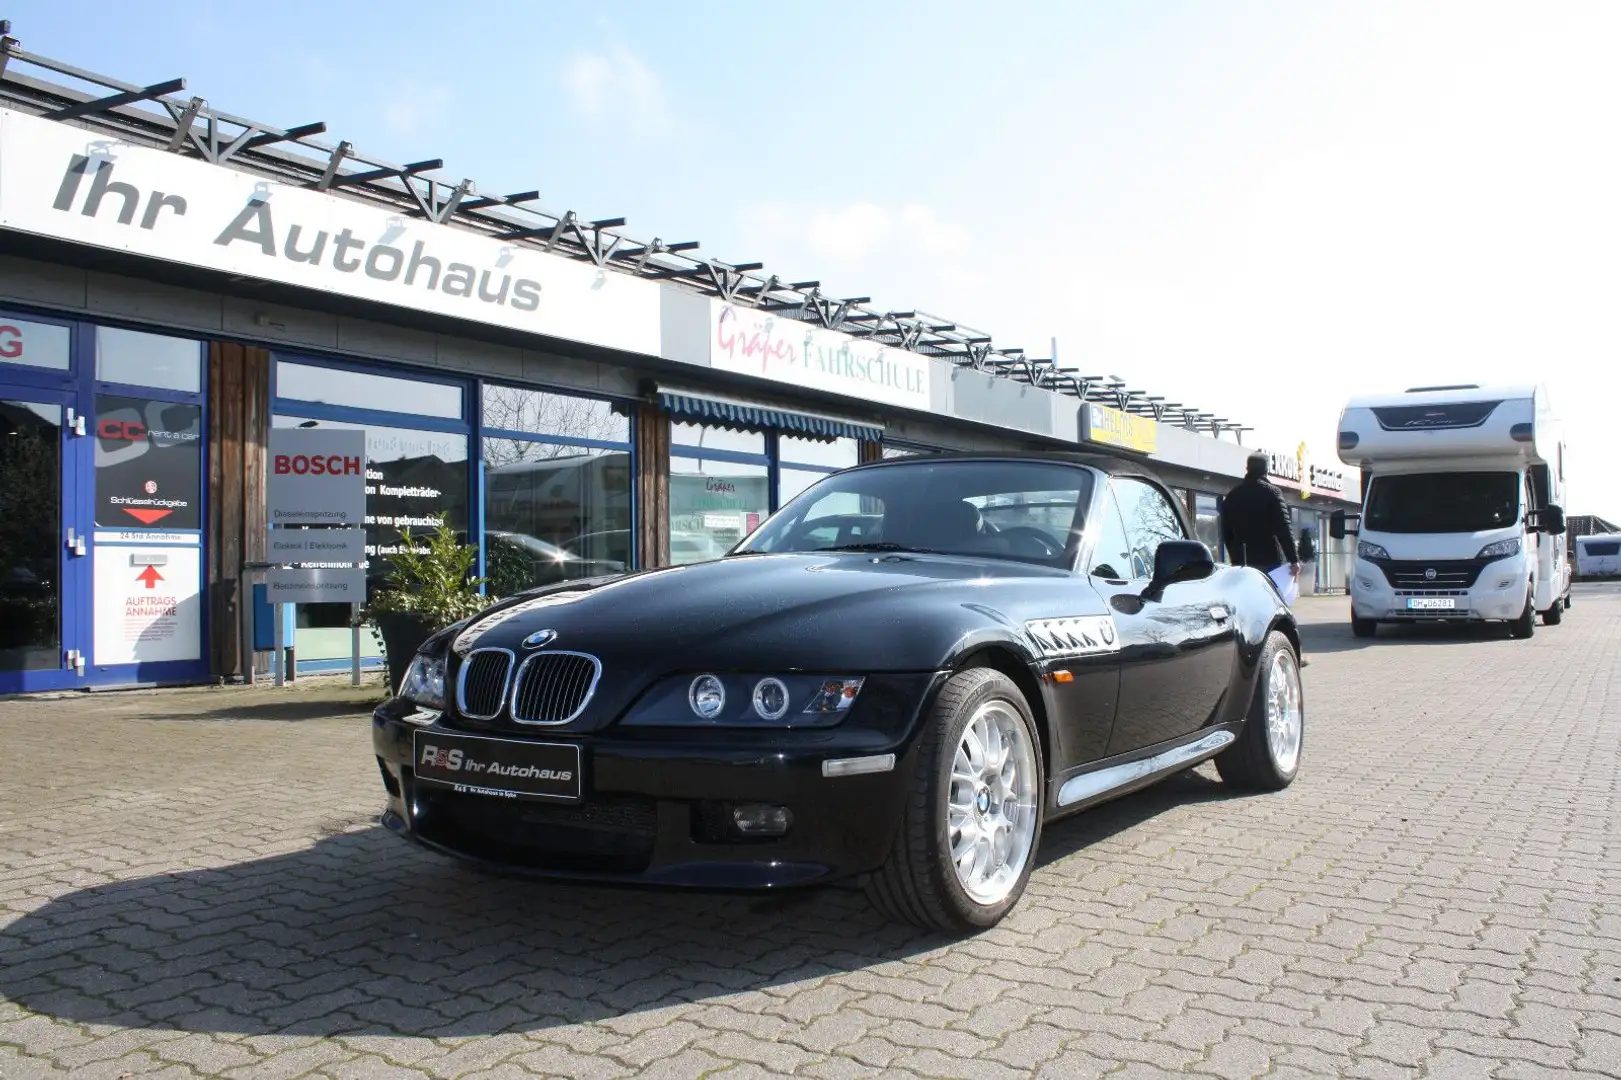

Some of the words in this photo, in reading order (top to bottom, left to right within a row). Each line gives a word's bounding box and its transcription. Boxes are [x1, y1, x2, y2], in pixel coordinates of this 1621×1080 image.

[52, 153, 187, 230] Ihr
[214, 195, 542, 312] Autohaus
[0, 325, 23, 358] G
[803, 340, 925, 394] FAHRSCHULE
[274, 455, 360, 475] BOSCH
[365, 469, 383, 480] tion
[380, 484, 441, 498] Kompletträder-
[110, 496, 187, 507] Schlüsselrückgabe
[377, 516, 393, 524] von
[121, 532, 130, 540] 24
[126, 596, 176, 606] AUFTRAGS
[125, 607, 177, 616] ANNAHME
[465, 759, 485, 772] Ihr
[486, 762, 573, 782] Autohaus
